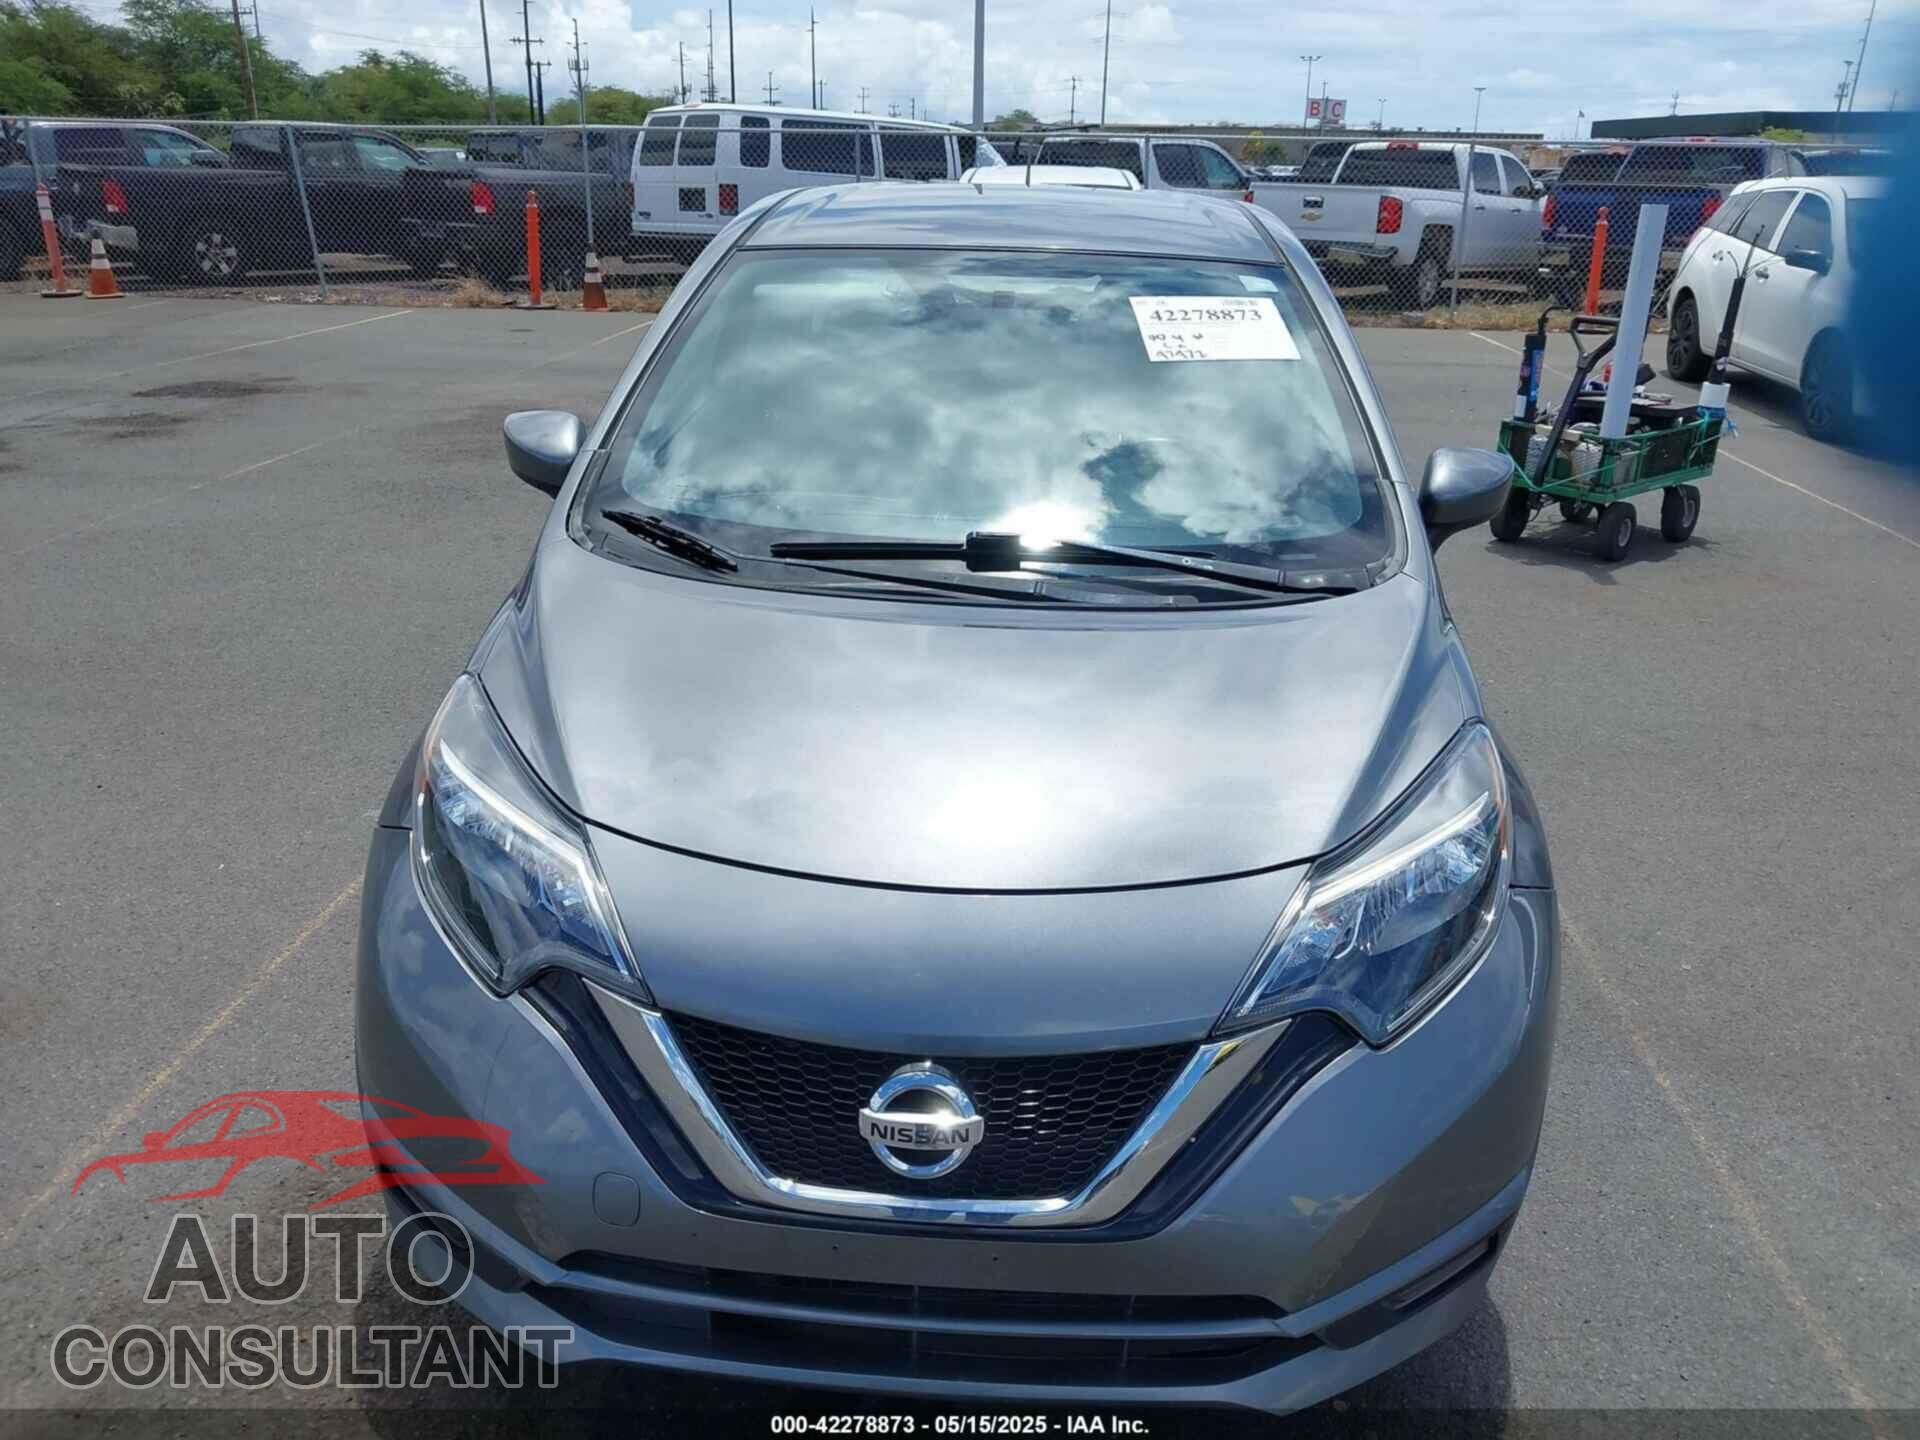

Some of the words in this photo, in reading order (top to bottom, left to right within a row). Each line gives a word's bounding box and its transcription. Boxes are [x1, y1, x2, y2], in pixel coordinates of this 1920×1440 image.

[1310, 101, 1321, 117] B
[1331, 102, 1343, 118] C
[1149, 308, 1263, 322] 42278873
[869, 1122, 970, 1145] NISSAN
